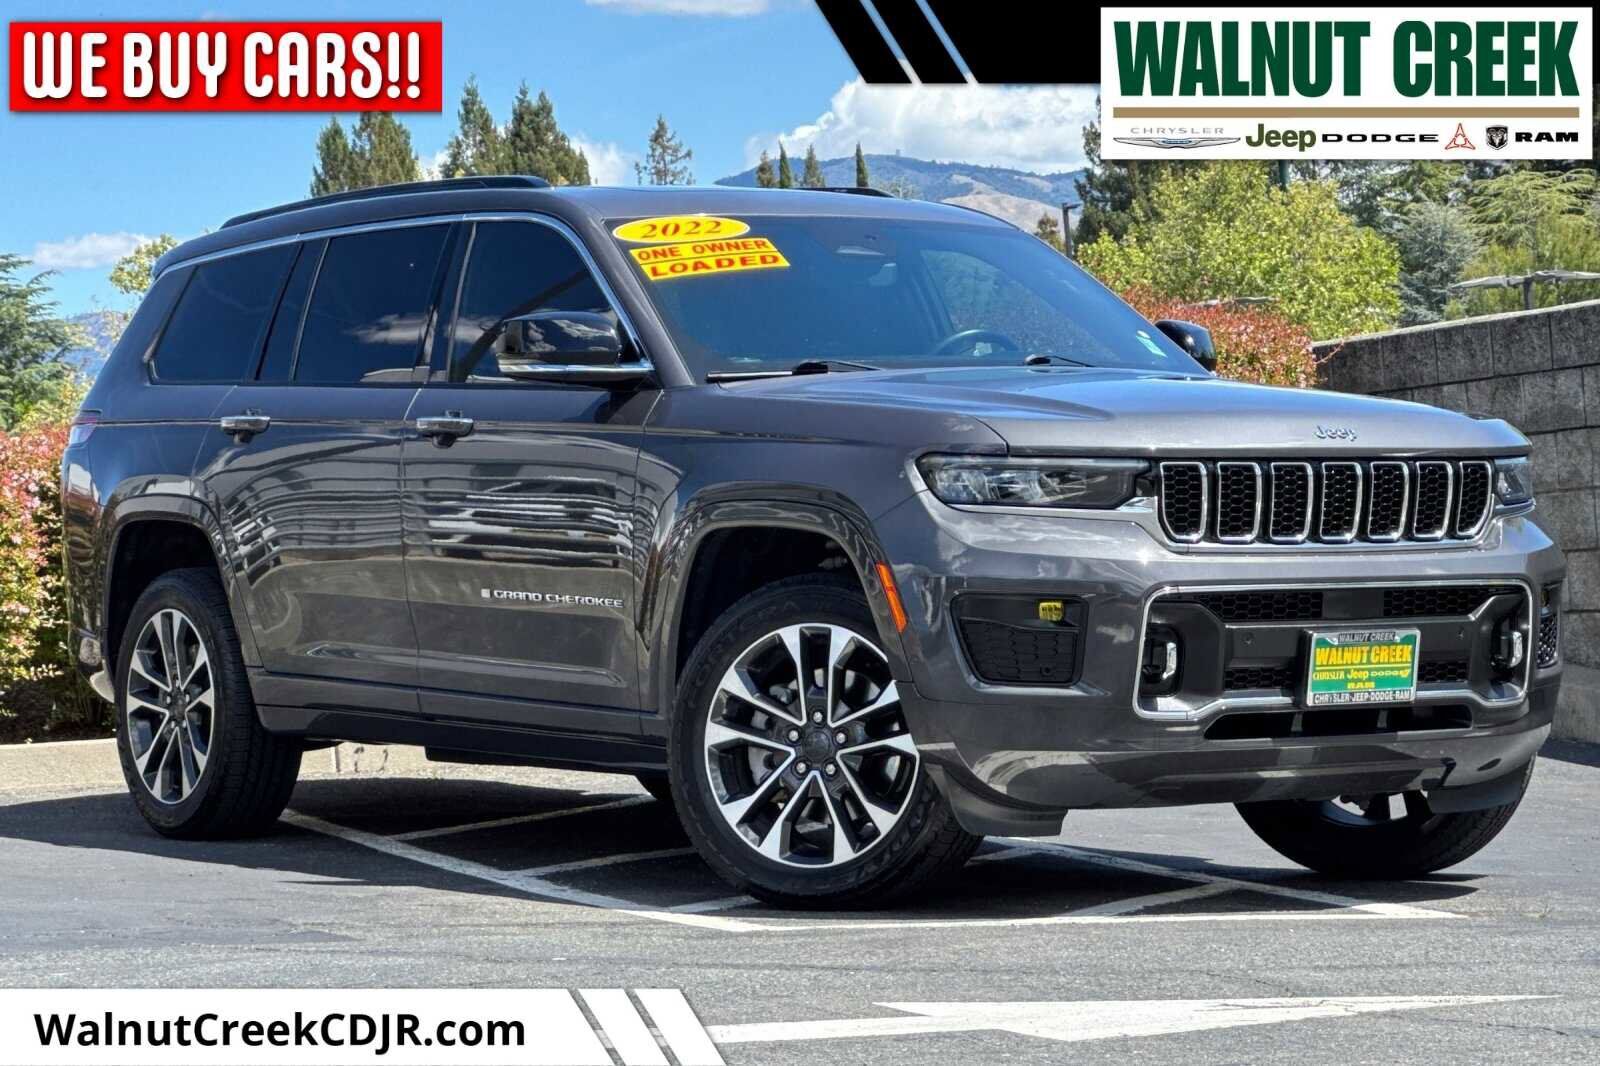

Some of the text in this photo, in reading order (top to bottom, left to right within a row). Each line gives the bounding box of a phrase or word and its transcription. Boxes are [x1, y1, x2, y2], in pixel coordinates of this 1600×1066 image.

[641, 220, 722, 239] 2022
[637, 239, 769, 261] ONE OWNER
[651, 254, 780, 277] LOADED
[1315, 425, 1358, 442] Jeep
[494, 590, 624, 608] GRAND CHEROKEE
[1339, 632, 1396, 642] WALNUT CREEK
[1315, 644, 1412, 665] WALNUT CREEK
[1347, 669, 1369, 680] Jeep
